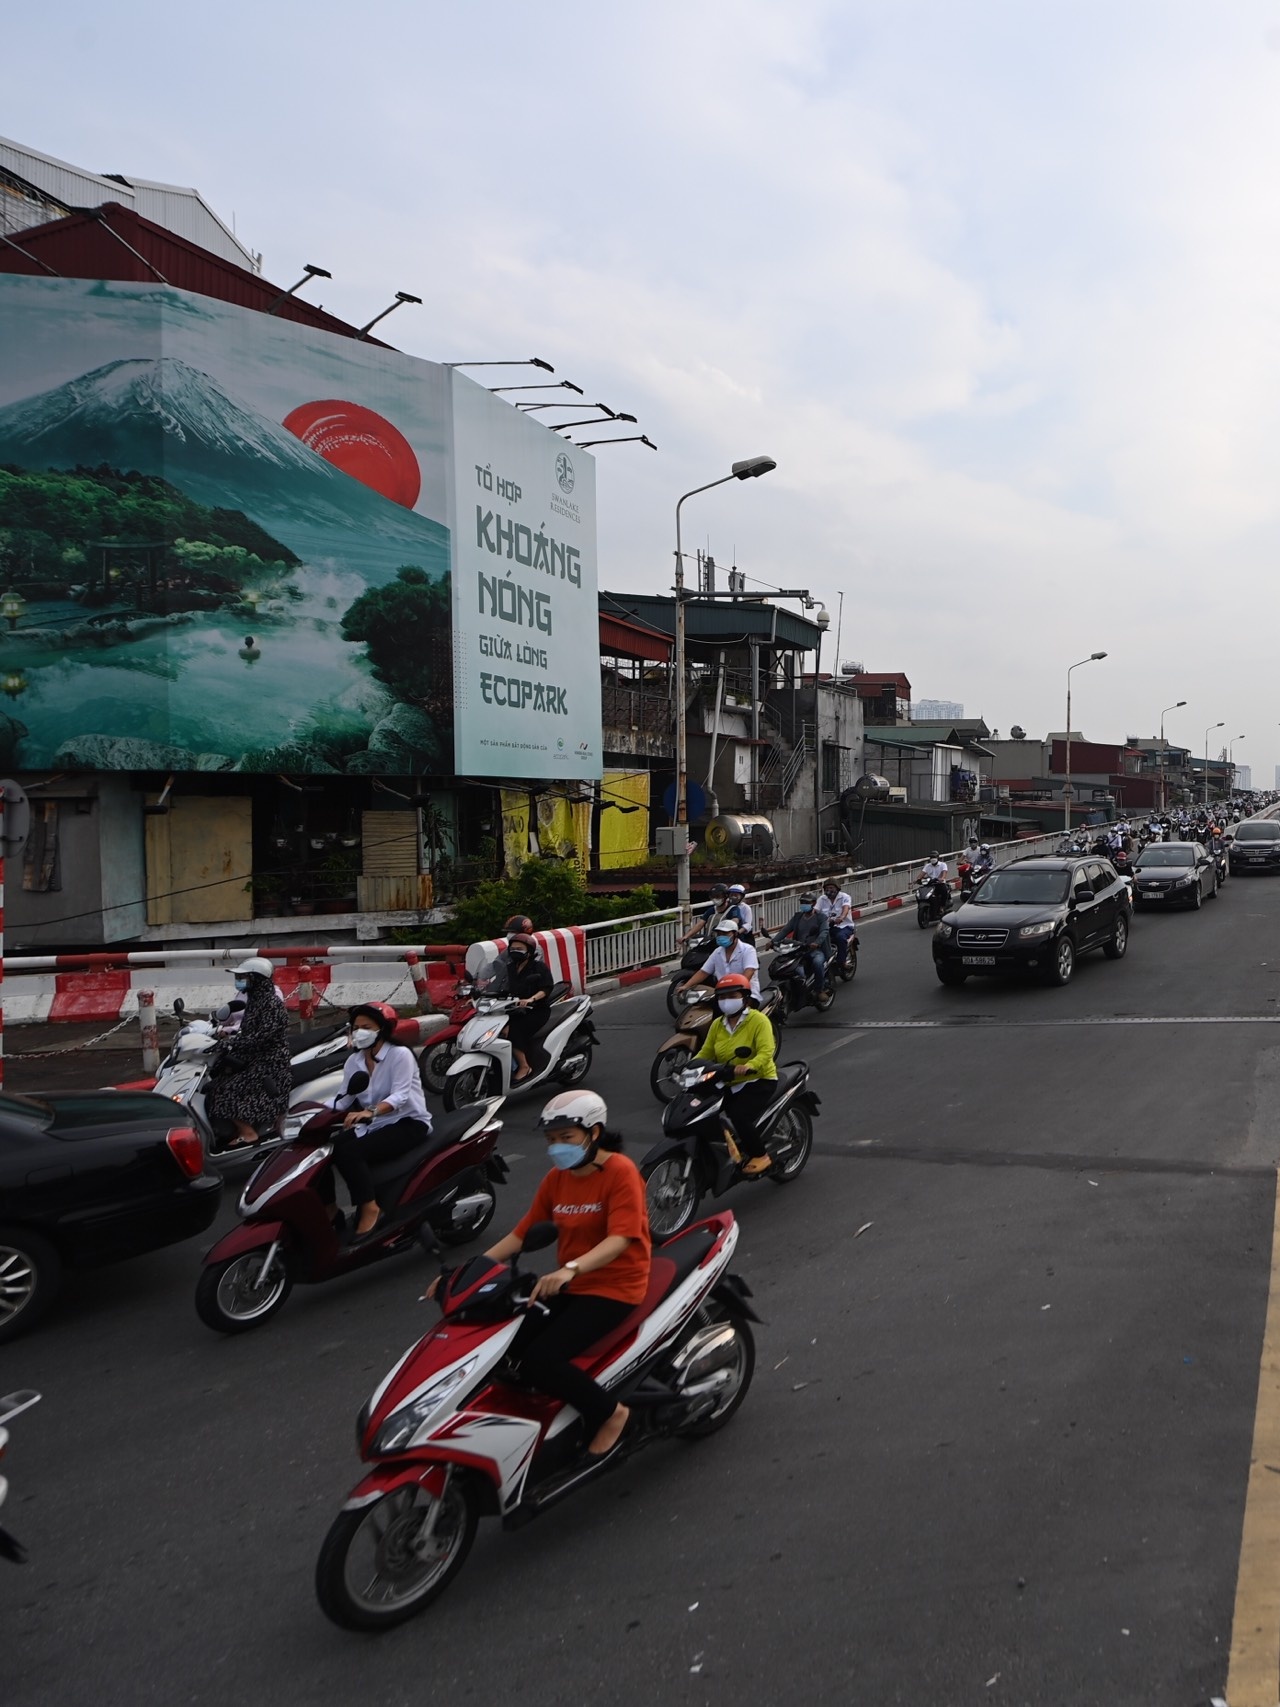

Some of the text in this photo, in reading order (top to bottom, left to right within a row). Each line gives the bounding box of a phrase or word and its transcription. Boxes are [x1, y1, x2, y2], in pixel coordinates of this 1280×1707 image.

[475, 463, 522, 506] TỔ HỢP
[551, 493, 580, 514] SWANLAKE
[550, 502, 581, 524] RESIDENCES
[476, 504, 581, 589] KHOÁNG
[478, 569, 552, 636] NÓNG
[516, 640, 548, 670] LÒNG
[479, 671, 568, 715] ECOPARK
